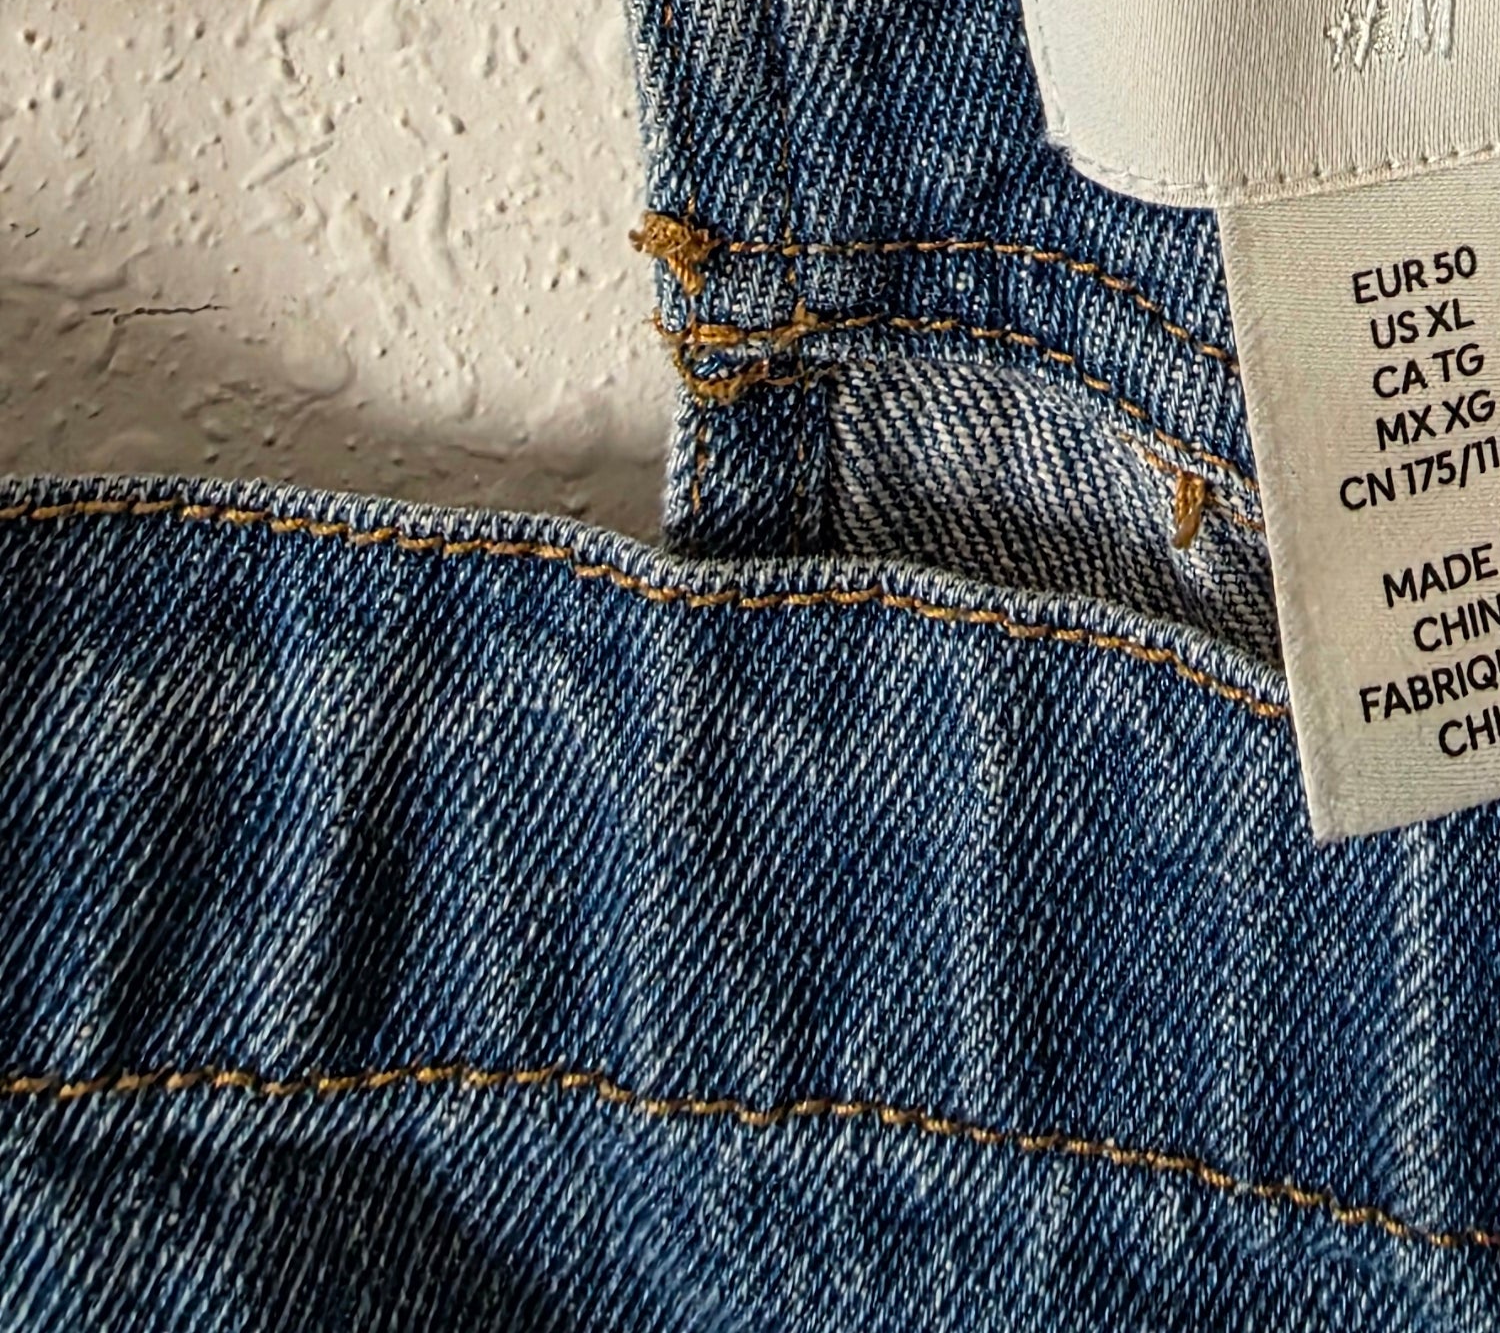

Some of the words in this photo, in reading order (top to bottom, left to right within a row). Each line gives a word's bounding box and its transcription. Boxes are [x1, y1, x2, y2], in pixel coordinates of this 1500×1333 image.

[1352, 258, 1428, 304] EUR
[1435, 245, 1478, 285] 50
[1370, 312, 1419, 349] US
[1426, 298, 1476, 338] XL
[1372, 365, 1429, 399] CA
[1432, 343, 1485, 383] TG
[1375, 405, 1436, 452] MX
[1441, 389, 1496, 433] XG
[1339, 467, 1396, 510] CN
[1382, 543, 1499, 609] MADE
